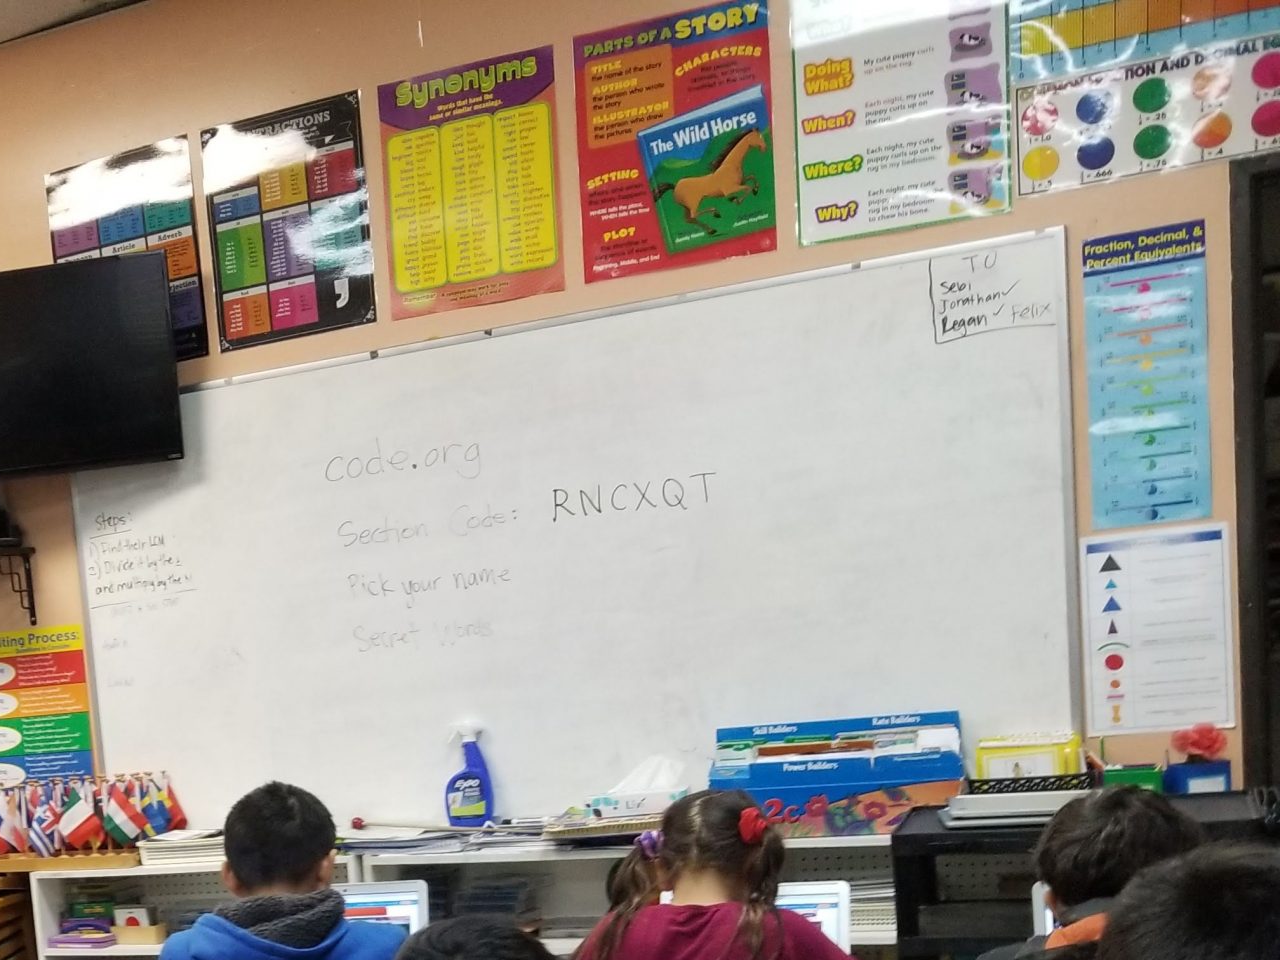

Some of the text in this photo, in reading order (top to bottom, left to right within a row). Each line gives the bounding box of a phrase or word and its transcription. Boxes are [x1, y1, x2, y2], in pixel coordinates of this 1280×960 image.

[584, 3, 759, 57] PARTS OF A STORY
[675, 45, 762, 77] CHARACTERS
[892, 51, 915, 62] puppy
[1160, 55, 1190, 73] AND
[591, 60, 622, 74] TITLE
[604, 71, 623, 79] name
[805, 59, 851, 78] Doing
[395, 56, 537, 109] Synonyms
[592, 78, 638, 95] AUTHOR
[805, 75, 852, 94] What?
[593, 101, 669, 124] ILLUSTRATOR
[803, 110, 855, 133] When?
[650, 111, 757, 156] The Wild Horse
[866, 146, 883, 155] Each
[919, 137, 934, 146] cute
[909, 149, 918, 157] up
[805, 155, 862, 179] Where?
[587, 169, 639, 190] SETTING
[818, 202, 857, 222] Why?
[158, 231, 183, 241] Adverb
[603, 226, 636, 243] PLOT
[1084, 226, 1203, 256] Fraction, Decimal, &
[111, 242, 136, 255] Article
[1086, 241, 1202, 270] Percent Equivalents
[325, 437, 480, 480] code.org
[337, 471, 717, 548] Section Code: RNCXQT
[347, 568, 511, 609] Pick your name
[783, 763, 807, 772] Power
